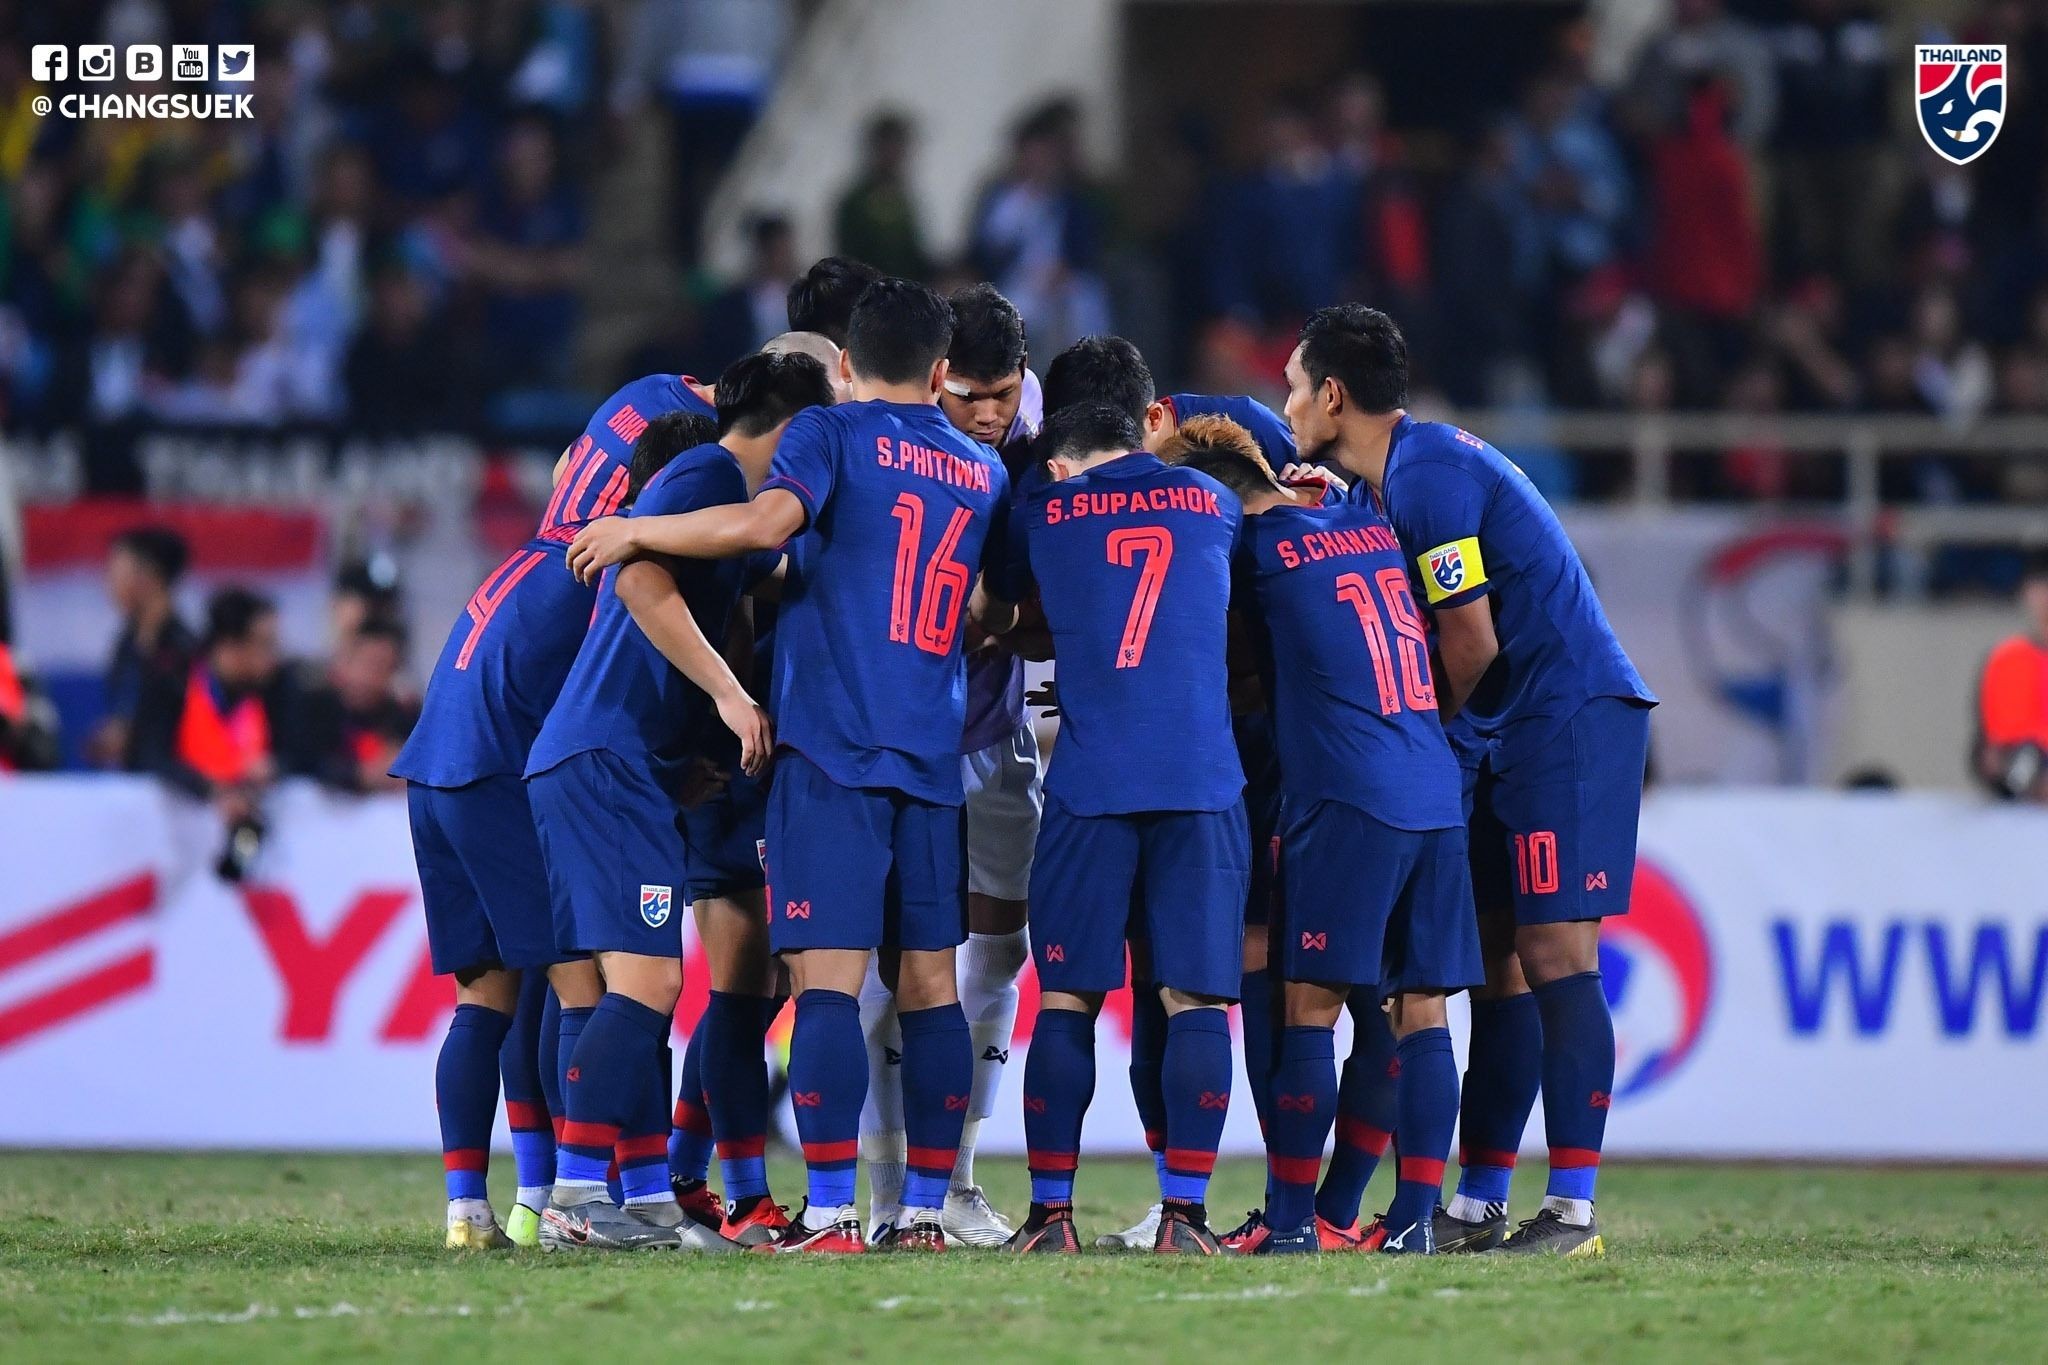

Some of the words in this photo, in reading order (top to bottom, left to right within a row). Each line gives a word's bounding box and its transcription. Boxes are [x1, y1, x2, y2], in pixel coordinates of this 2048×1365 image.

[607, 404, 649, 445] BIHR
[876, 436, 991, 495] S.PHITIWAT
[1046, 486, 1222, 526] S.SUPACHOK
[889, 491, 973, 657] 16
[1276, 525, 1400, 569] S.CHANATH
[1429, 545, 1458, 561] THAILAND
[455, 549, 548, 671] 4
[1106, 525, 1174, 669] 7
[1335, 567, 1438, 715] 18
[642, 886, 671, 894] THAILAND
[1515, 831, 1559, 895] 10
